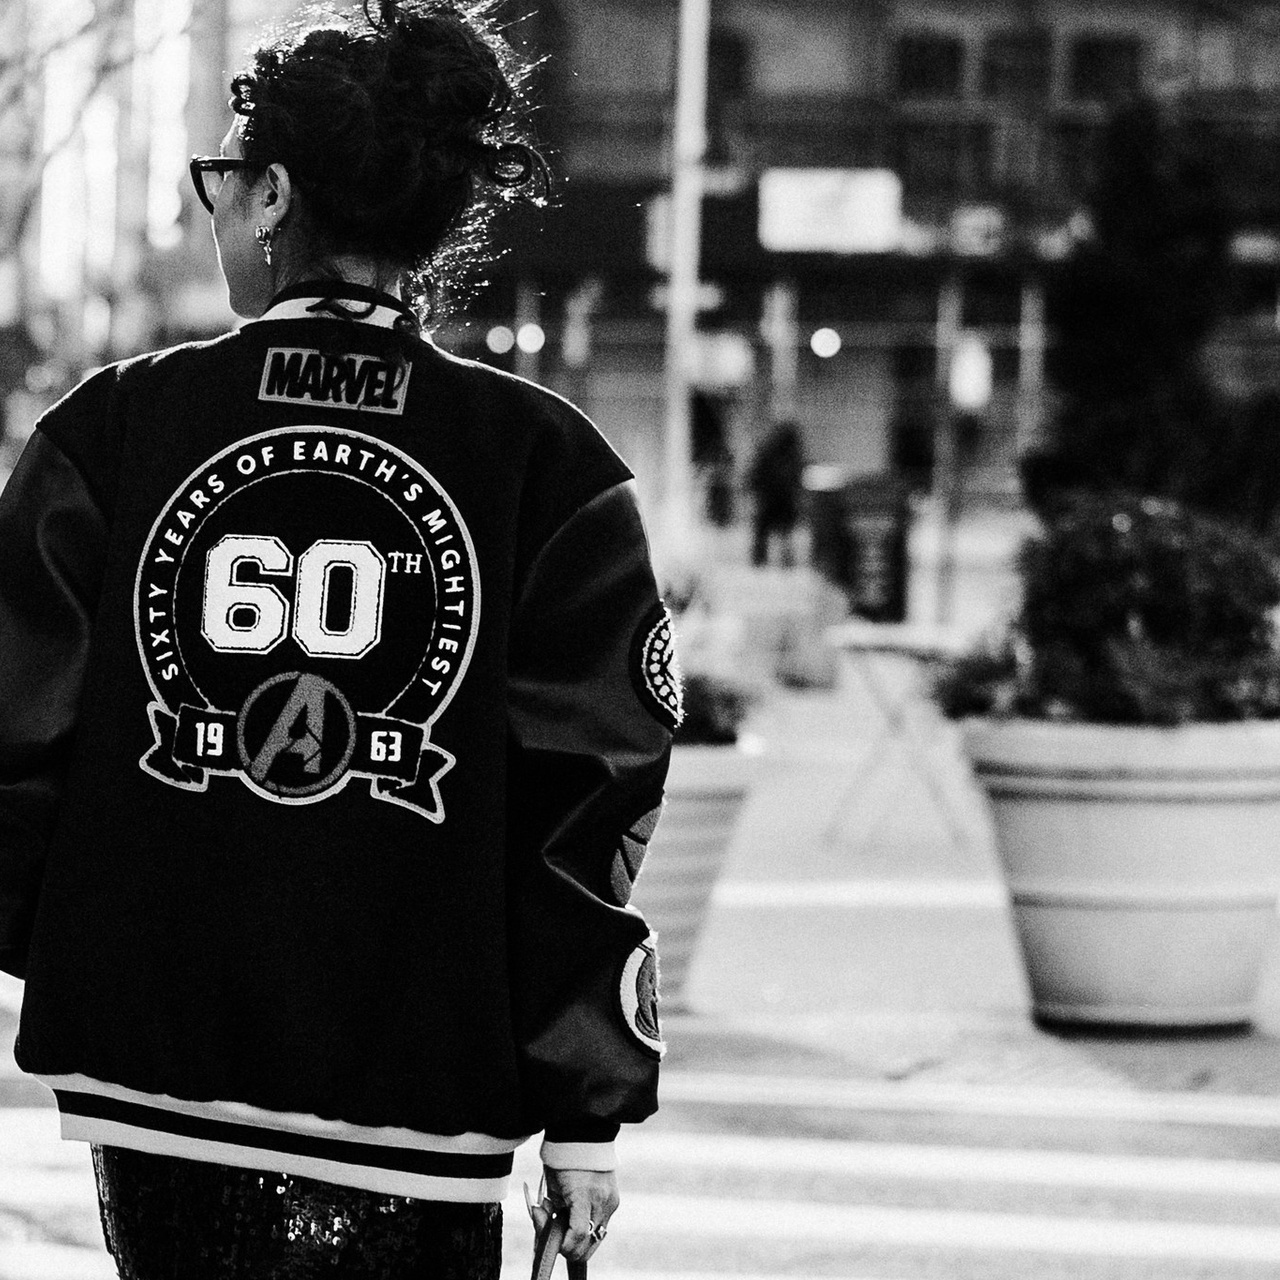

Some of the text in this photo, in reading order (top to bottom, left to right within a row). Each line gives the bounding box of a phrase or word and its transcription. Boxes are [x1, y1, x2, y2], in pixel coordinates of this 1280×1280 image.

[266, 351, 398, 409] MARVEL
[148, 441, 465, 696] SIXTY YEARS OF EARTH'S MIGHTIEST
[195, 722, 402, 763] 19 63
